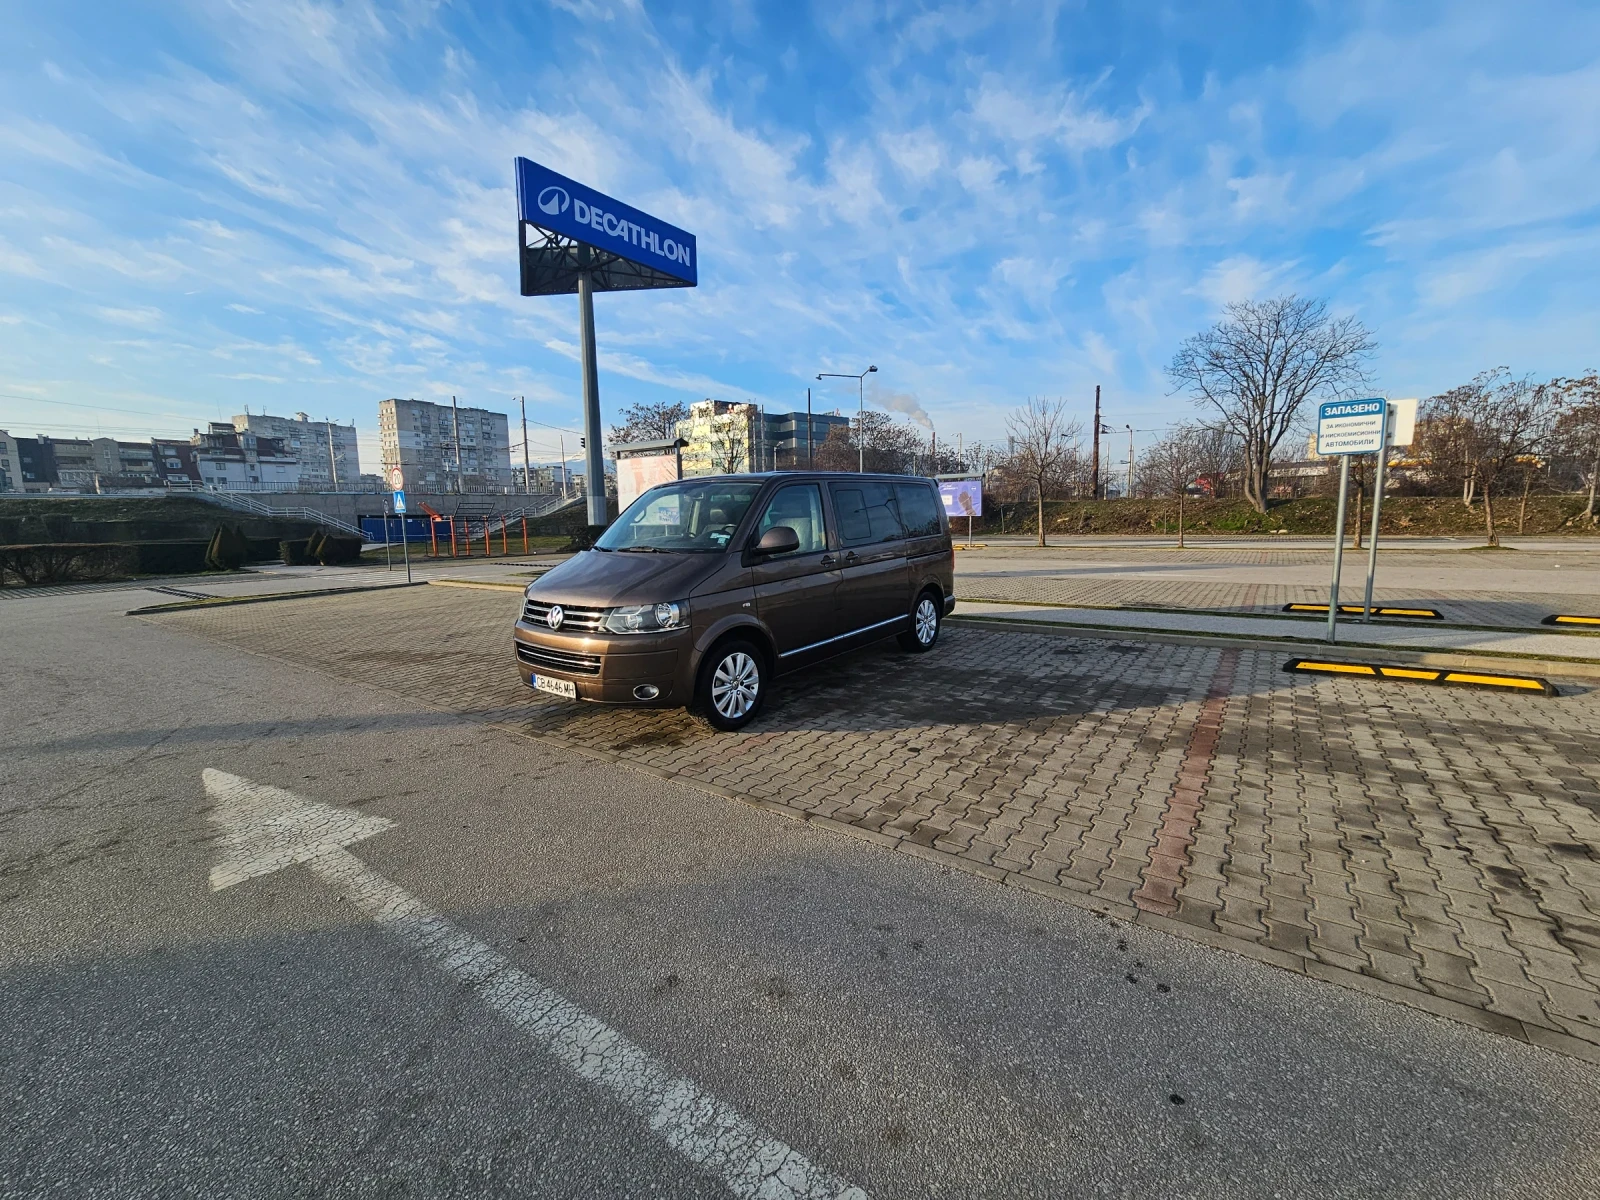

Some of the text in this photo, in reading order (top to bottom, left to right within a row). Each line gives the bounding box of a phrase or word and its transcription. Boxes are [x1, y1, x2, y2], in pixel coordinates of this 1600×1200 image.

[573, 198, 691, 267] DECATHLON
[1324, 403, 1380, 416] ЗАПАЗЕНО
[1325, 430, 1381, 438] НИСКОЕМИСИОННИ
[1325, 439, 1374, 448] АВТОМОБИЛИ
[394, 473, 402, 485] 20
[546, 679, 563, 693] 4646
